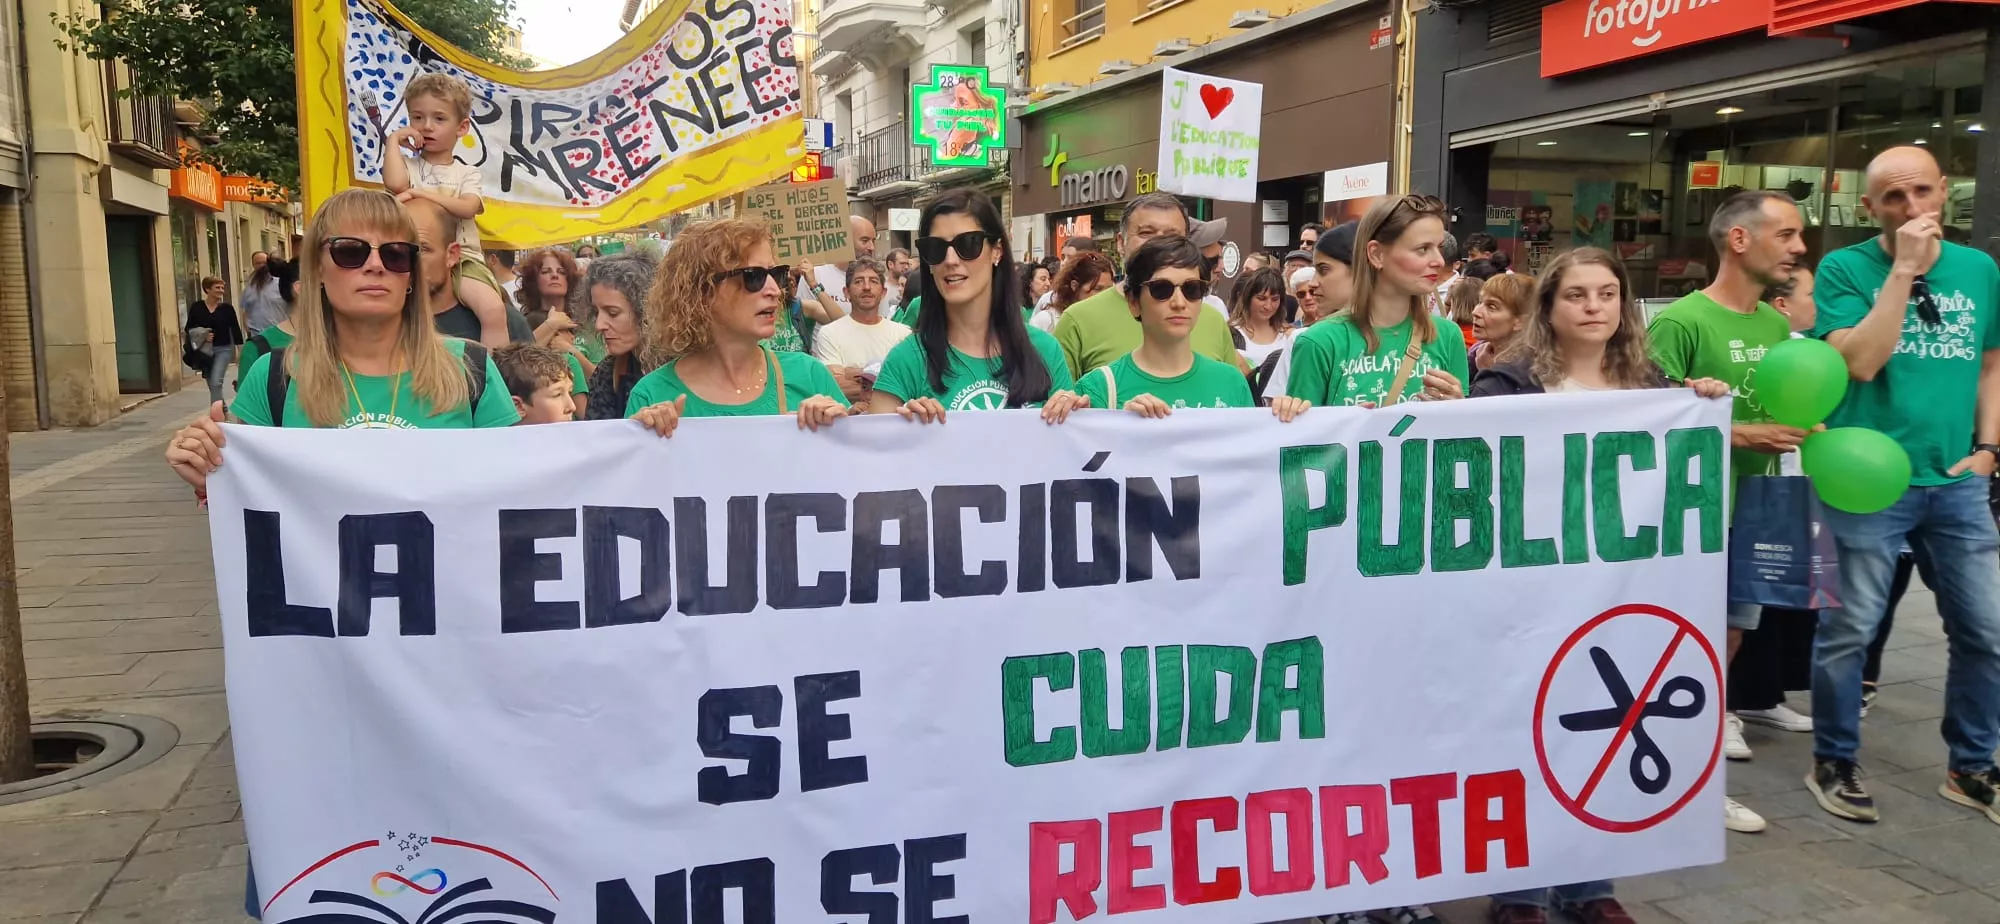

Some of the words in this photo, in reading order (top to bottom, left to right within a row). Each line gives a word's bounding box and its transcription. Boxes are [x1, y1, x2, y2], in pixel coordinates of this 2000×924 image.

[1584, 0, 1724, 38] fotopr
[786, 186, 830, 206] HIJ@S
[1061, 164, 1129, 206] marro
[794, 203, 839, 219] OBRERO
[796, 217, 842, 232] QUIEREN
[770, 230, 848, 258] STUDIAR
[243, 508, 436, 638] LA
[498, 450, 1201, 635] EDUCACIÓN
[1279, 415, 1724, 586] PÚBLICA
[696, 670, 869, 805] SE
[1002, 635, 1326, 767] CUIDA
[820, 832, 970, 924] SE
[1028, 769, 1530, 924] RECORTA
